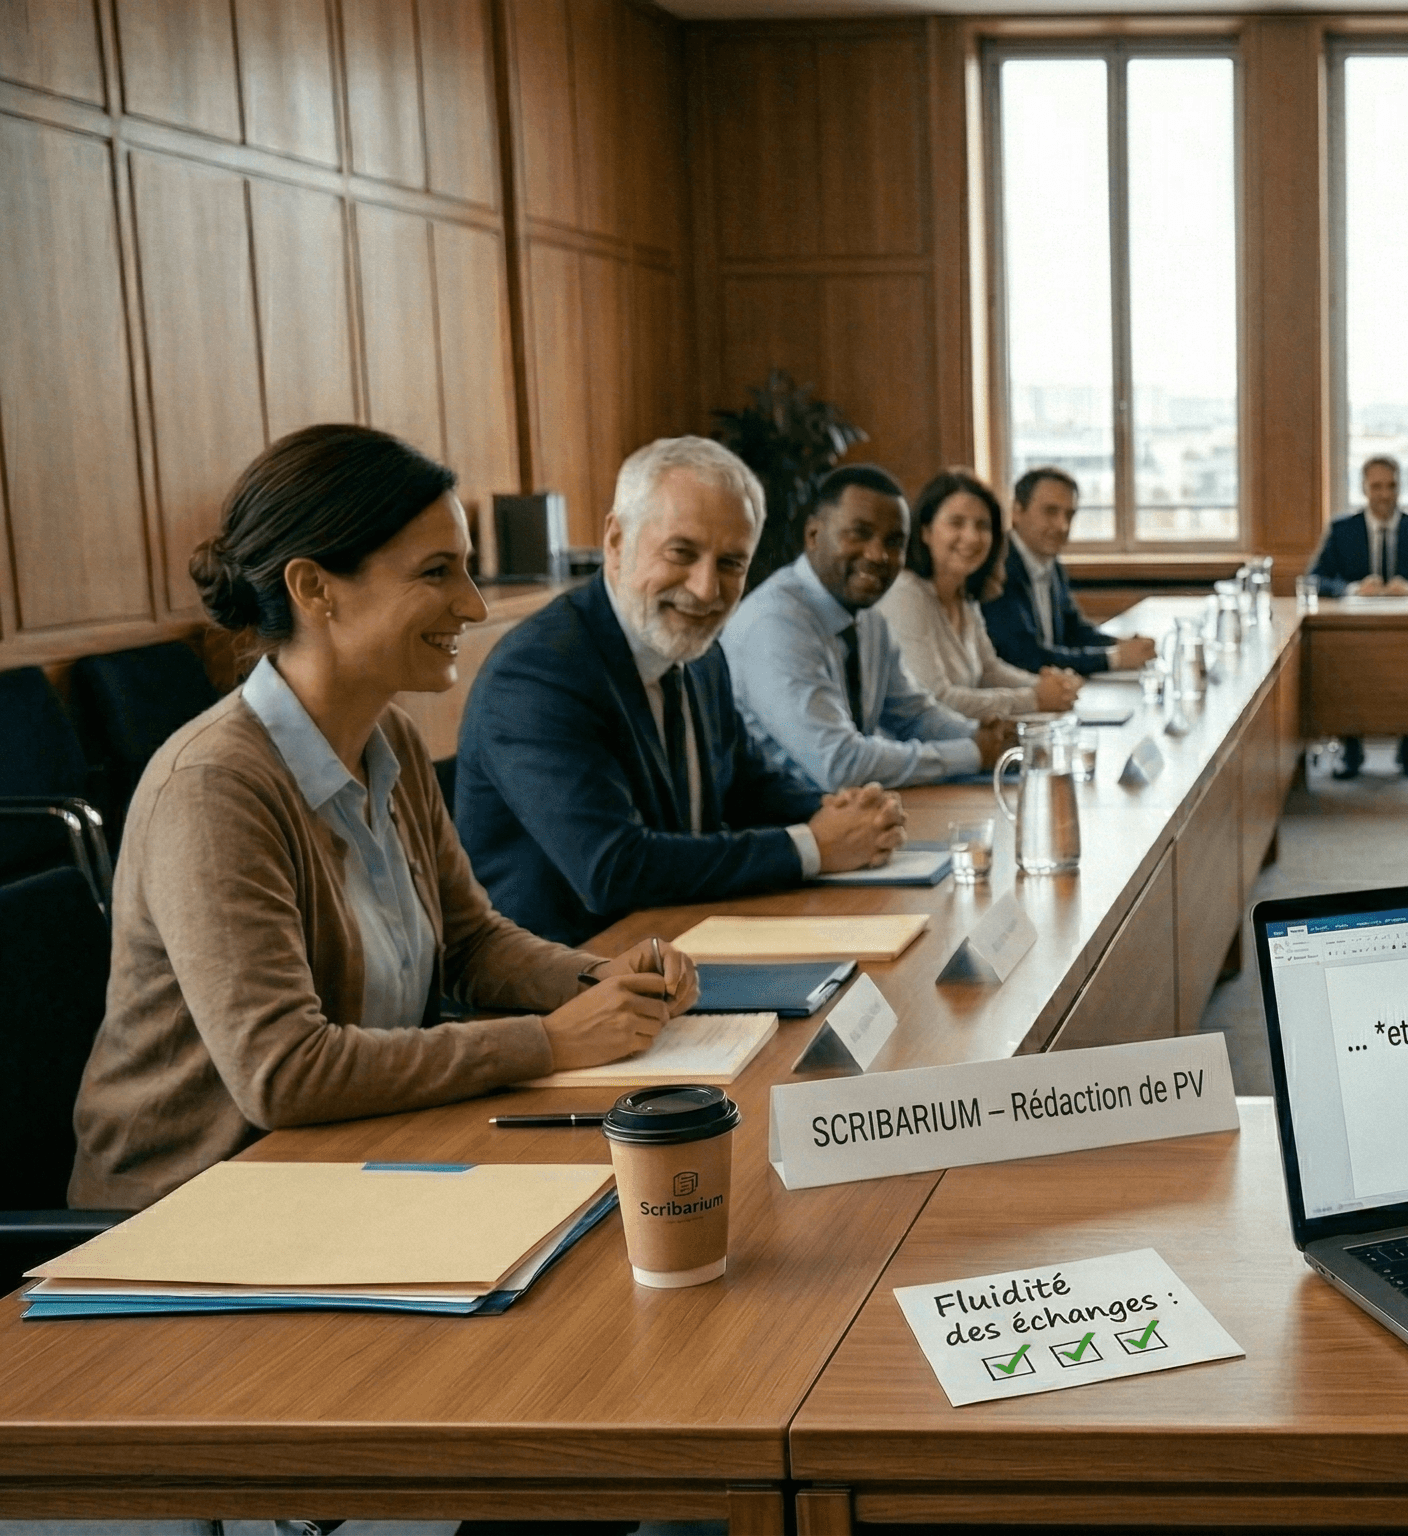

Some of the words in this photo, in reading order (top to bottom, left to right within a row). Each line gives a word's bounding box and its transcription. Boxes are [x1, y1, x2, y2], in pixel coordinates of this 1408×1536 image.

[812, 1097, 982, 1148] SCRIBARIUM
[1010, 1082, 1132, 1122] Rédaction
[1139, 1074, 1168, 1106] de
[1173, 1069, 1205, 1100] PV
[640, 1194, 723, 1217] Scribarium
[933, 1272, 1072, 1318] Fluidité
[946, 1322, 1001, 1346] des
[1012, 1292, 1158, 1334] échanges
